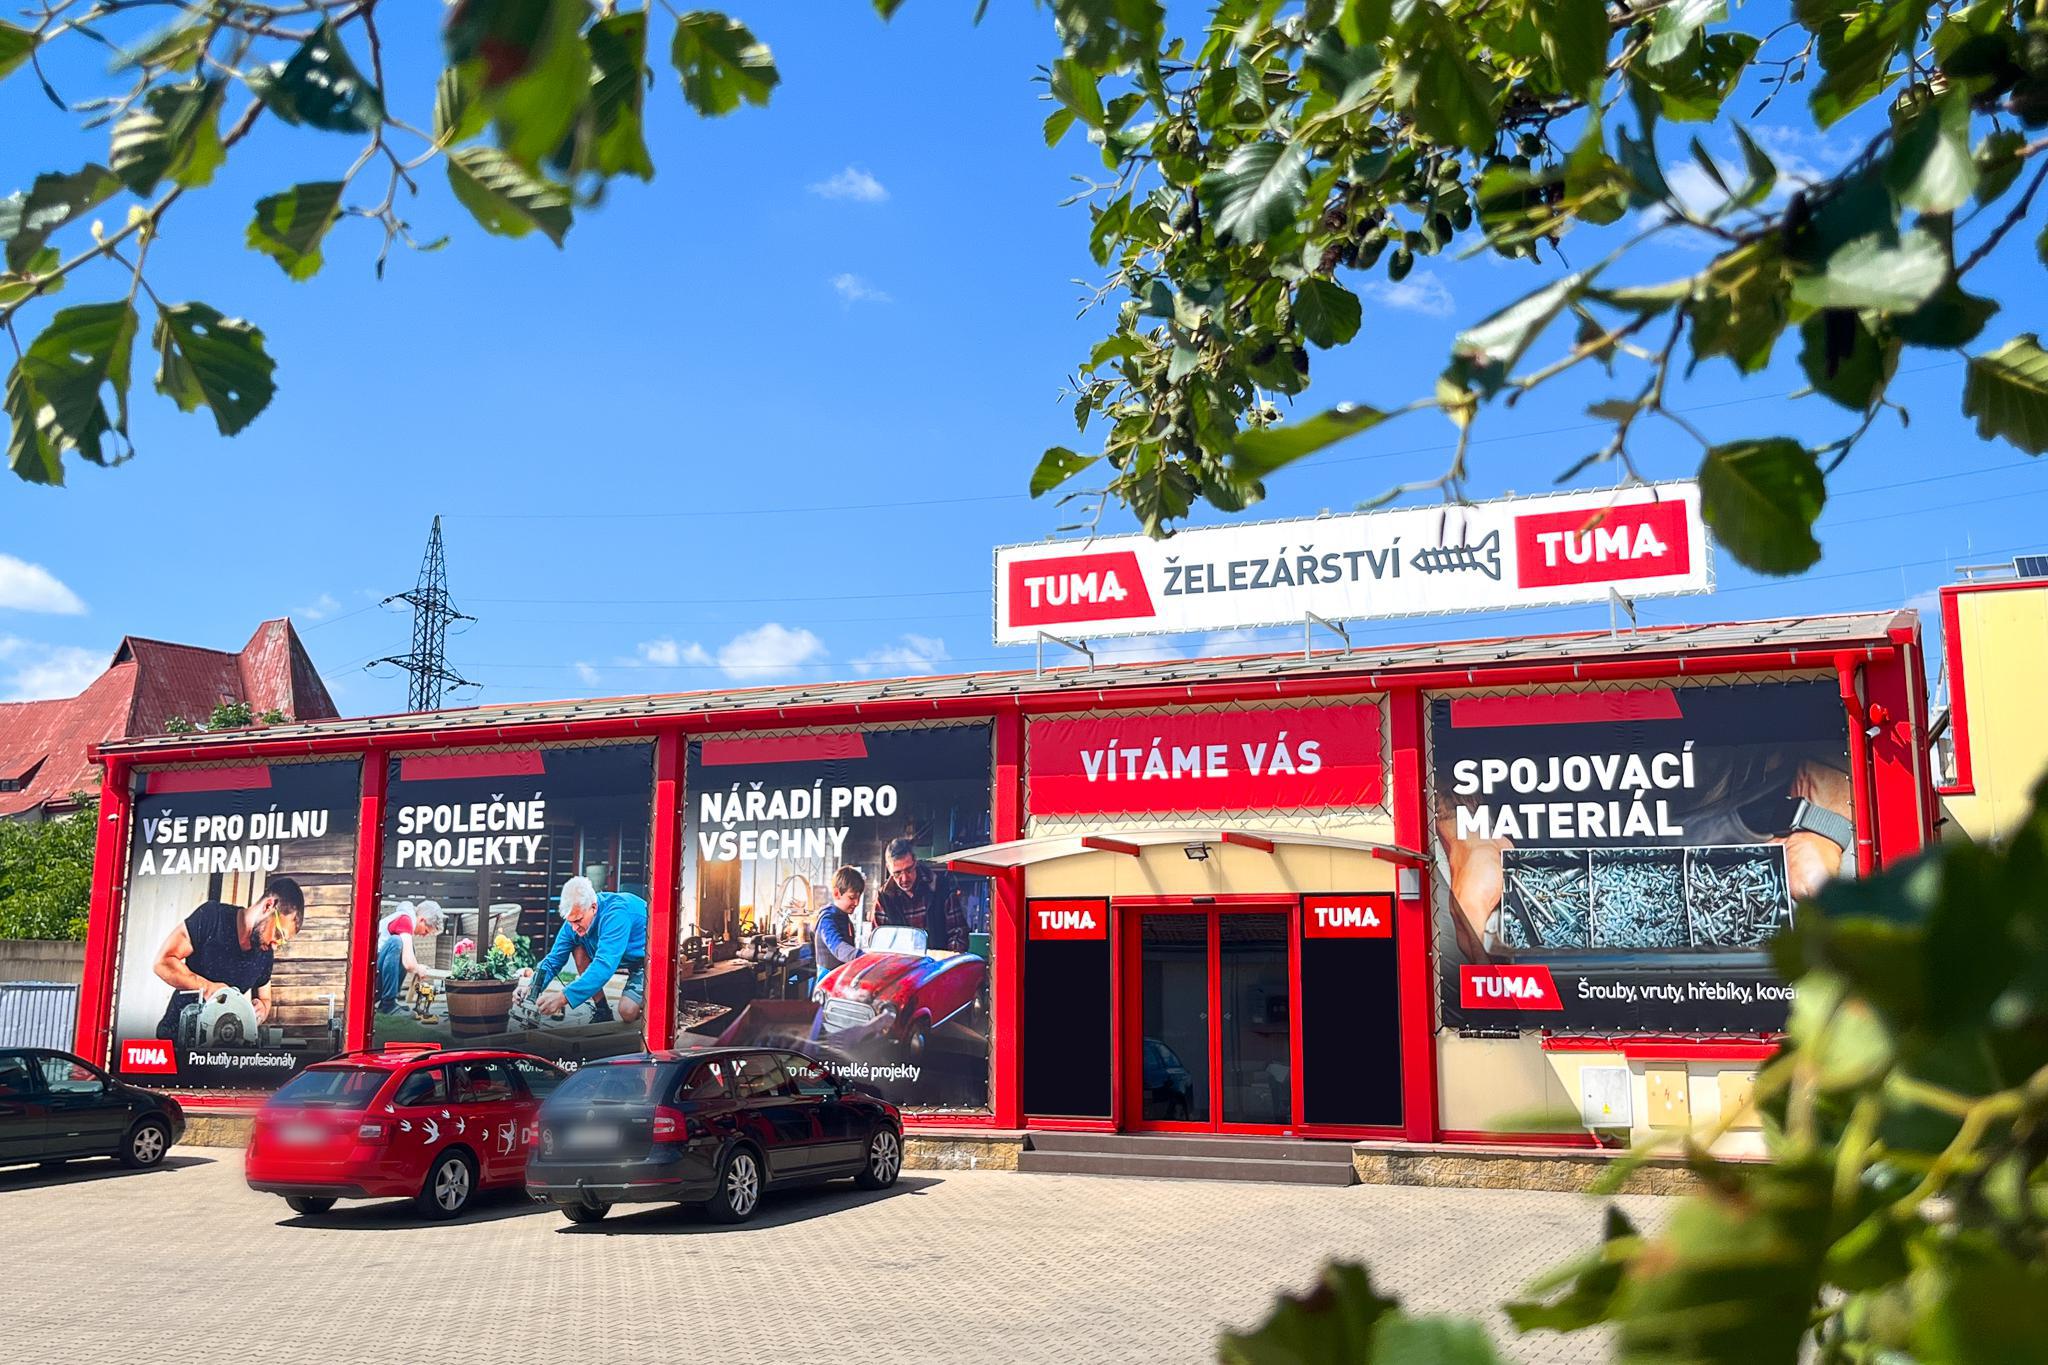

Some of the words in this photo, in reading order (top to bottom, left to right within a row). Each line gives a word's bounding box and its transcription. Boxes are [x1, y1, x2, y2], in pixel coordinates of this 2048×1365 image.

[1024, 570, 1128, 609] TUMA
[1163, 537, 1401, 597] ŽELEZÁŘSTVÍ
[1536, 522, 1668, 568] TUMA
[1080, 737, 1229, 782] VÍTÁME
[1242, 731, 1321, 776] VÁS
[1452, 740, 1695, 795] SPOJOVACÍ
[397, 792, 546, 835] SPOLEČNÉ
[700, 778, 824, 824] NÁŘADÍ
[831, 784, 898, 818] PRO
[1456, 789, 1684, 841] MATERIÁL
[143, 809, 189, 844] VŠE
[194, 814, 244, 843] PRO
[250, 804, 329, 841] DÍLNU
[396, 835, 543, 868] PROJEKTY
[698, 821, 850, 861] VŠECHNY
[138, 848, 157, 876] A
[161, 844, 281, 875] ZAHRADU
[1038, 910, 1097, 930] TUMA
[1314, 907, 1381, 927] TUMA
[1471, 976, 1545, 999] TUMA
[1577, 977, 1638, 1003] Šrouby,
[1640, 982, 1685, 1004] vruty,
[1687, 981, 1752, 1004] hřebíky,
[127, 1048, 168, 1065] TUMA
[188, 1051, 206, 1065] Pro
[232, 1055, 239, 1066] a
[239, 1053, 297, 1070] profesionály
[831, 1061, 836, 1075] i
[837, 1062, 869, 1078] velké
[871, 1063, 921, 1081] projekty
